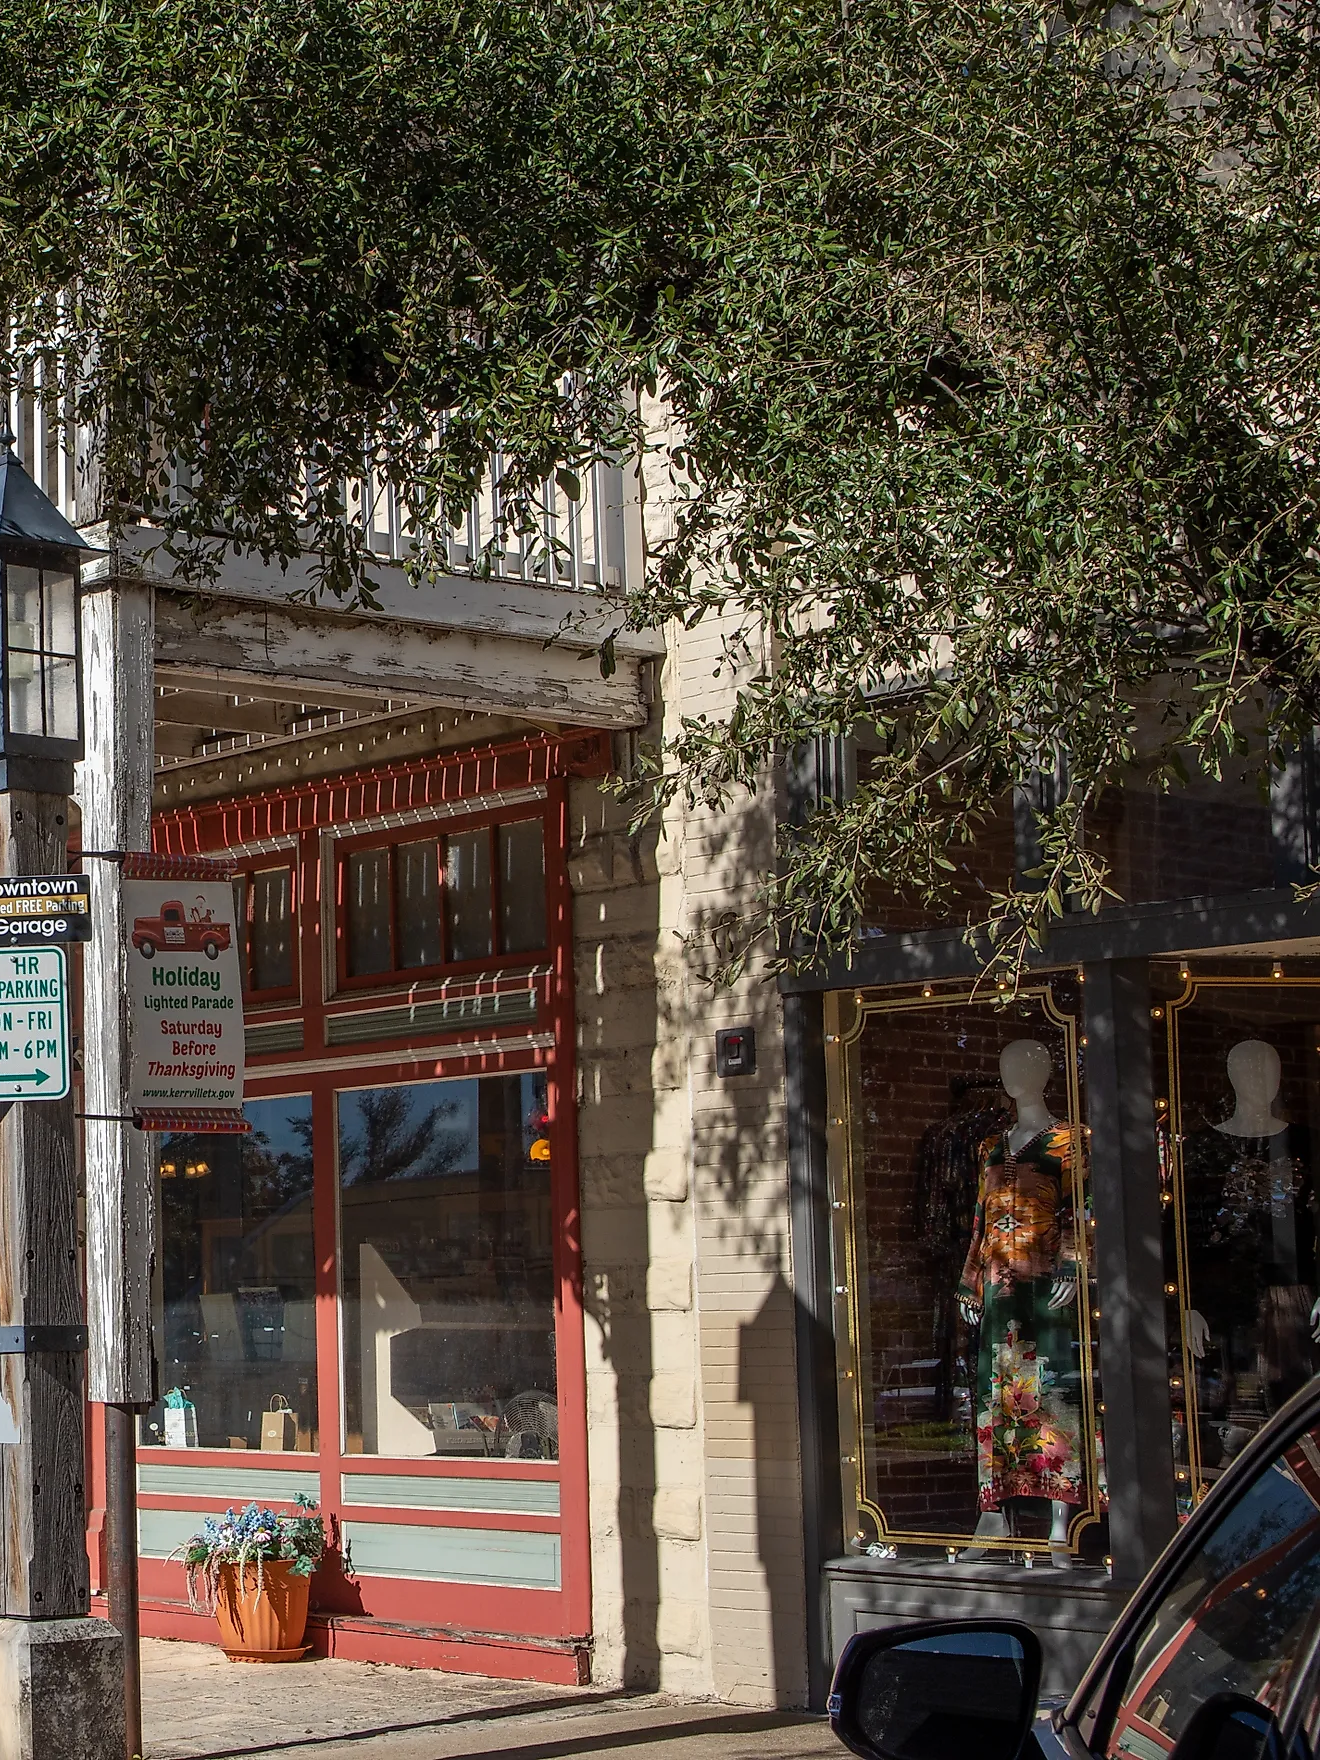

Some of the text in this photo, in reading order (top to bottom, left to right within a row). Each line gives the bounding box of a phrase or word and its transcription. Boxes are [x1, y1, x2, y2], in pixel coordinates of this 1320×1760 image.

[15, 899, 42, 914] FREE
[45, 898, 85, 914] Parking
[15, 957, 39, 975] HR
[151, 966, 221, 992] Holiday
[144, 996, 235, 1012] Lighted Parade
[160, 1019, 223, 1039] Saturday
[172, 1040, 217, 1056] Before
[147, 1061, 236, 1081] Thanksgiving
[142, 1087, 235, 1101] www.kerrvilletx.gov
